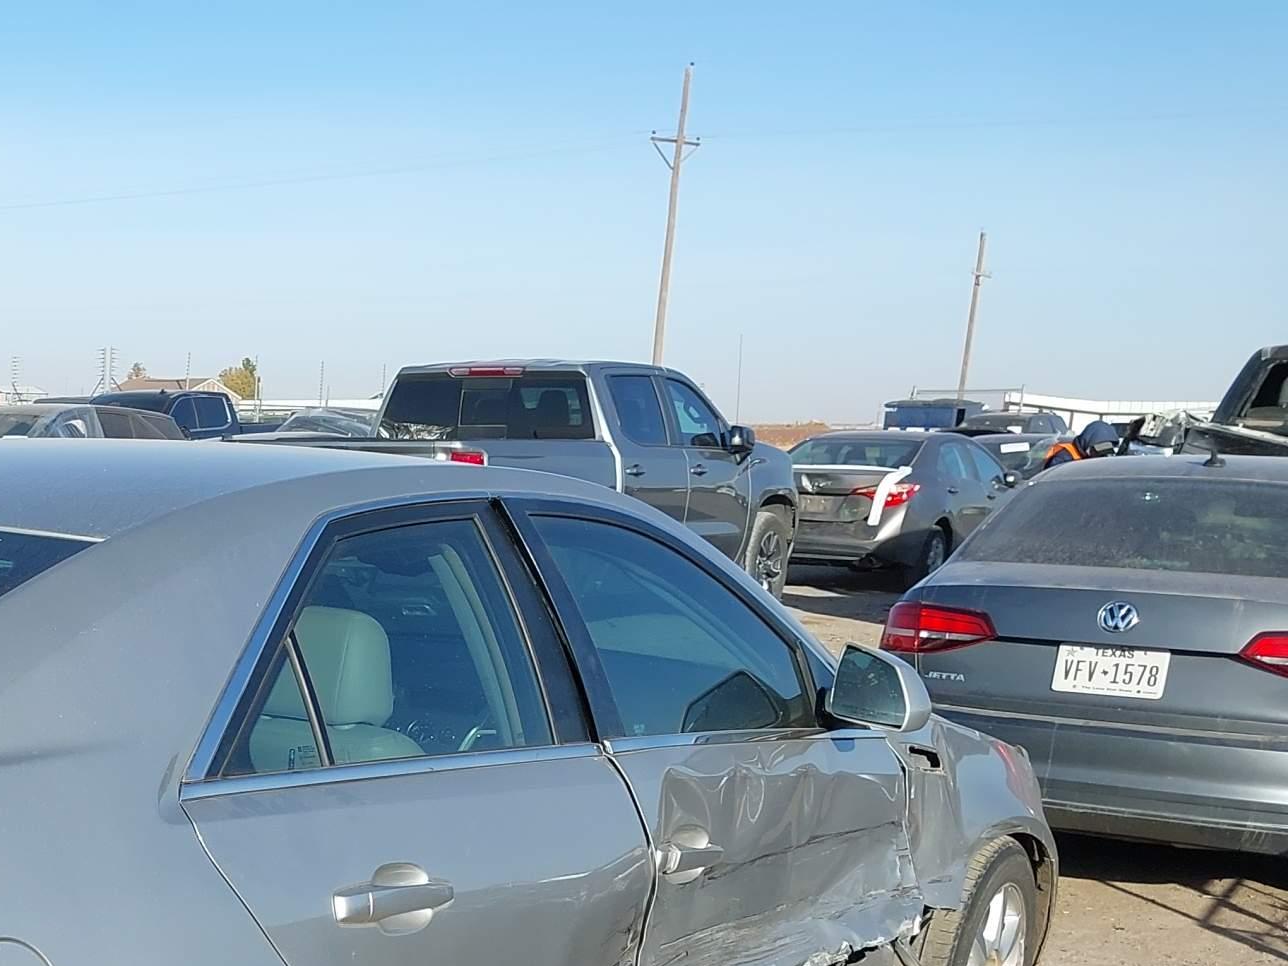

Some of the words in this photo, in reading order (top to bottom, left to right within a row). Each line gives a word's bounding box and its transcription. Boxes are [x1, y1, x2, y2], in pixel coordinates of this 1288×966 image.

[1095, 648, 1136, 659] TEXAS
[924, 671, 966, 682] JETTA
[1109, 662, 1160, 687] 1578
